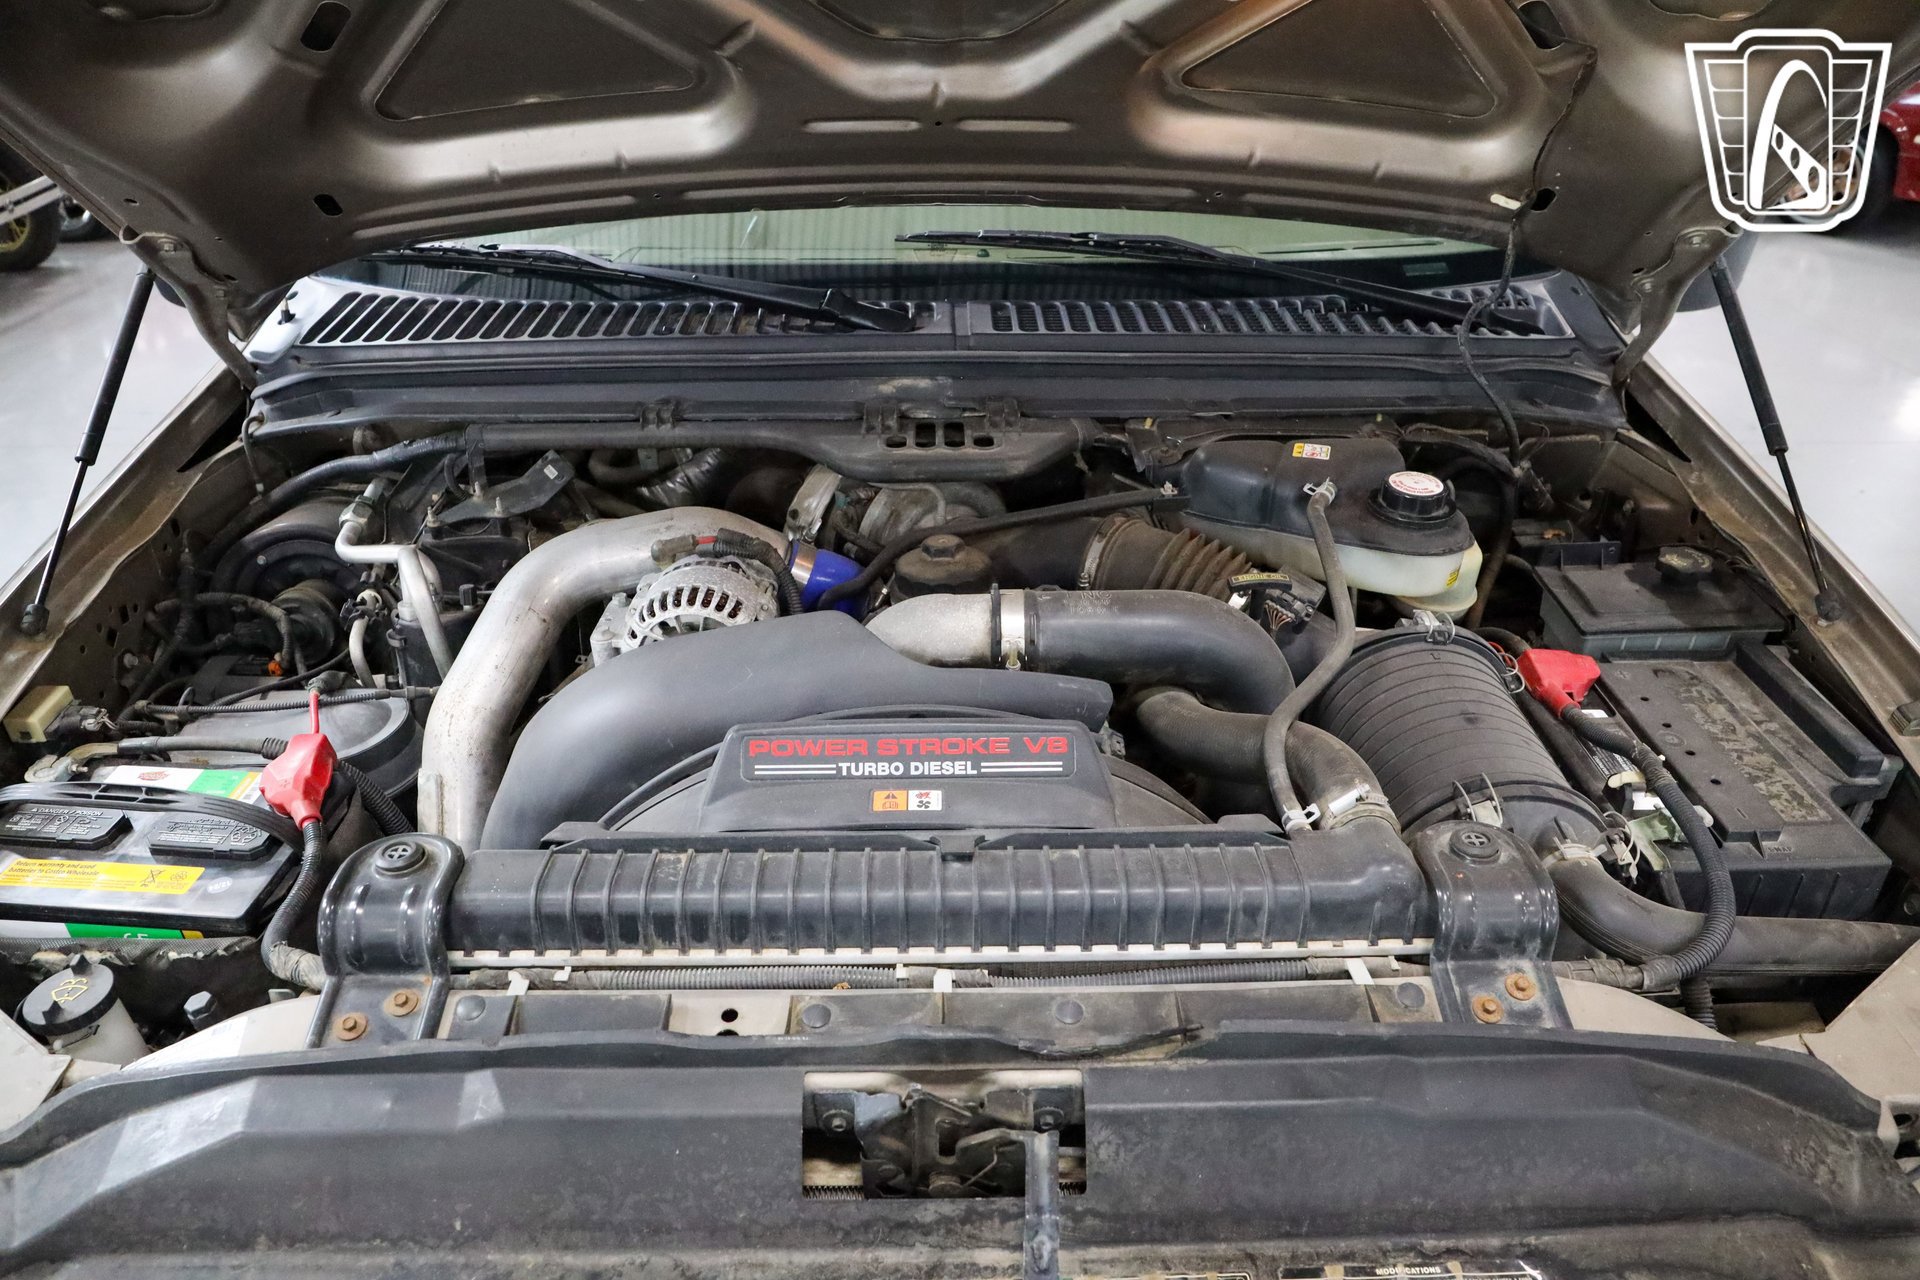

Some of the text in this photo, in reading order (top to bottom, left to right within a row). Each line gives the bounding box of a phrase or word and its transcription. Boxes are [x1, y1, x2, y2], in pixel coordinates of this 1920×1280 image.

[748, 736, 1069, 757] POWER STROKE V8
[838, 761, 978, 777] TURBO DIESEL
[66, 868, 100, 876] Wholesale
[1375, 1266, 1441, 1275] MODICATIONS
